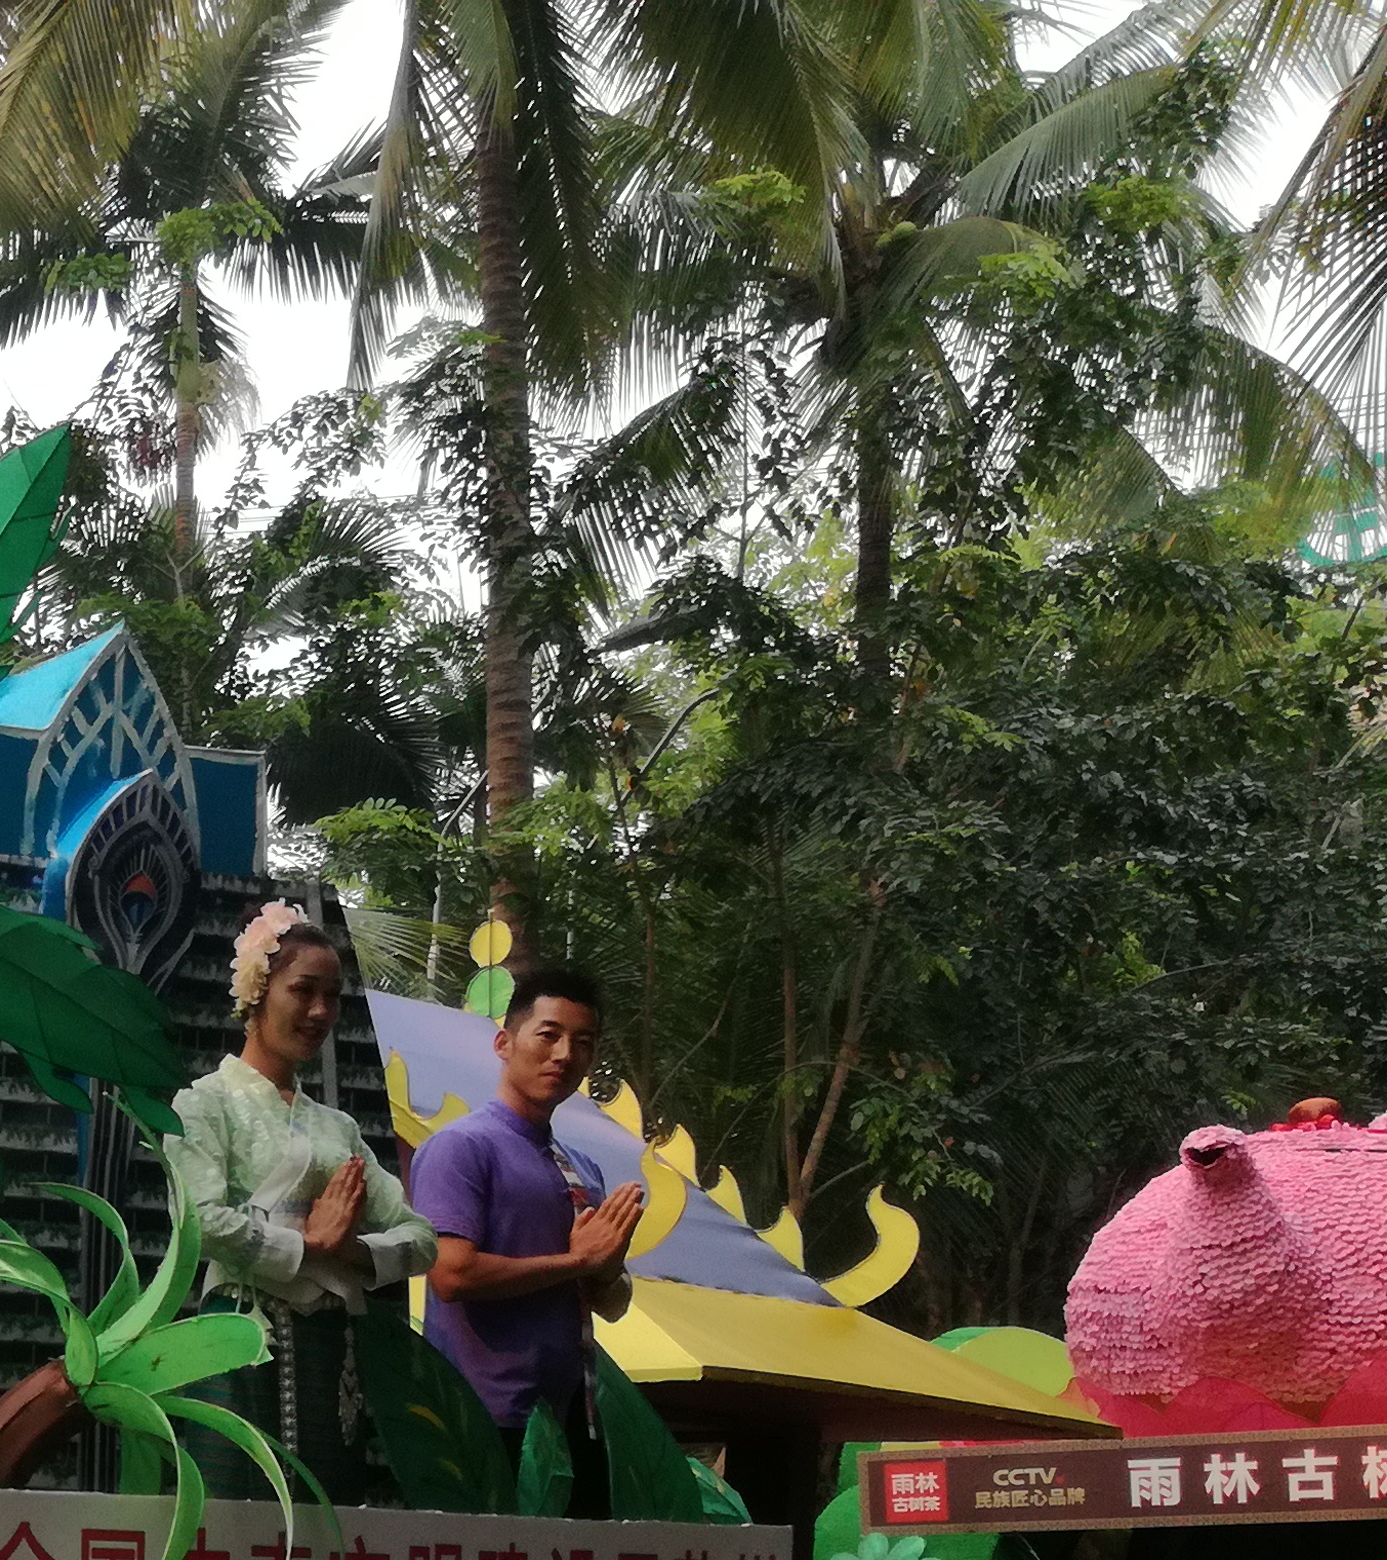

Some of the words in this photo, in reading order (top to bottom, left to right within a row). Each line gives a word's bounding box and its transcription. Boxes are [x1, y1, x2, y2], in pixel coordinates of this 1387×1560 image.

[891, 1472, 940, 1496] 雨林
[993, 1467, 1057, 1487] CCTV
[892, 1496, 941, 1514] 古树茶
[975, 1487, 1086, 1510] 民族匠心品牌
